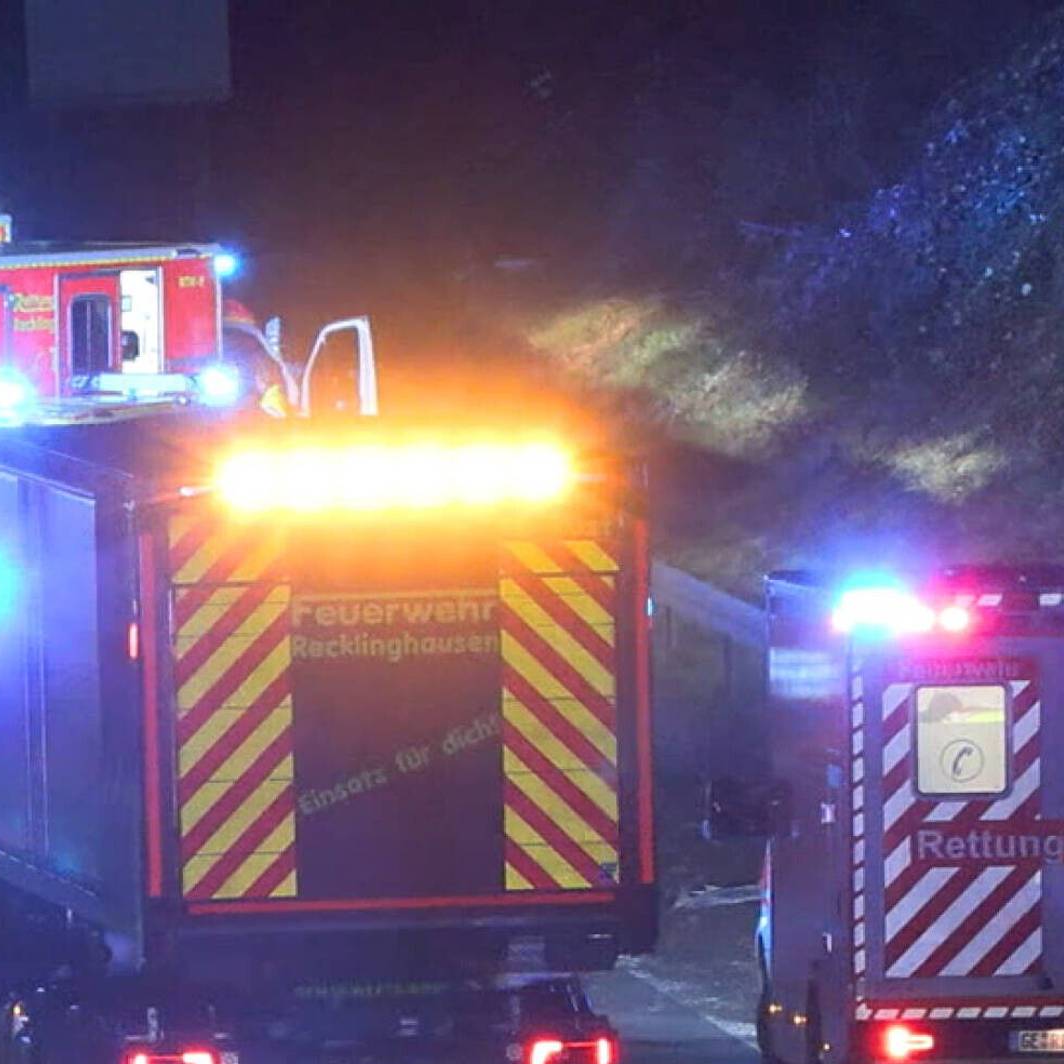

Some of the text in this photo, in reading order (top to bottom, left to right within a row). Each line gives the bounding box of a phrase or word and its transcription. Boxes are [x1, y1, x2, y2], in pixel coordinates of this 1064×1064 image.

[291, 597, 498, 627] Feuerwehr
[291, 631, 499, 662] Recklinghausen
[298, 768, 388, 816] Einsatz
[395, 744, 431, 774] für
[917, 829, 1064, 864] Rettung
